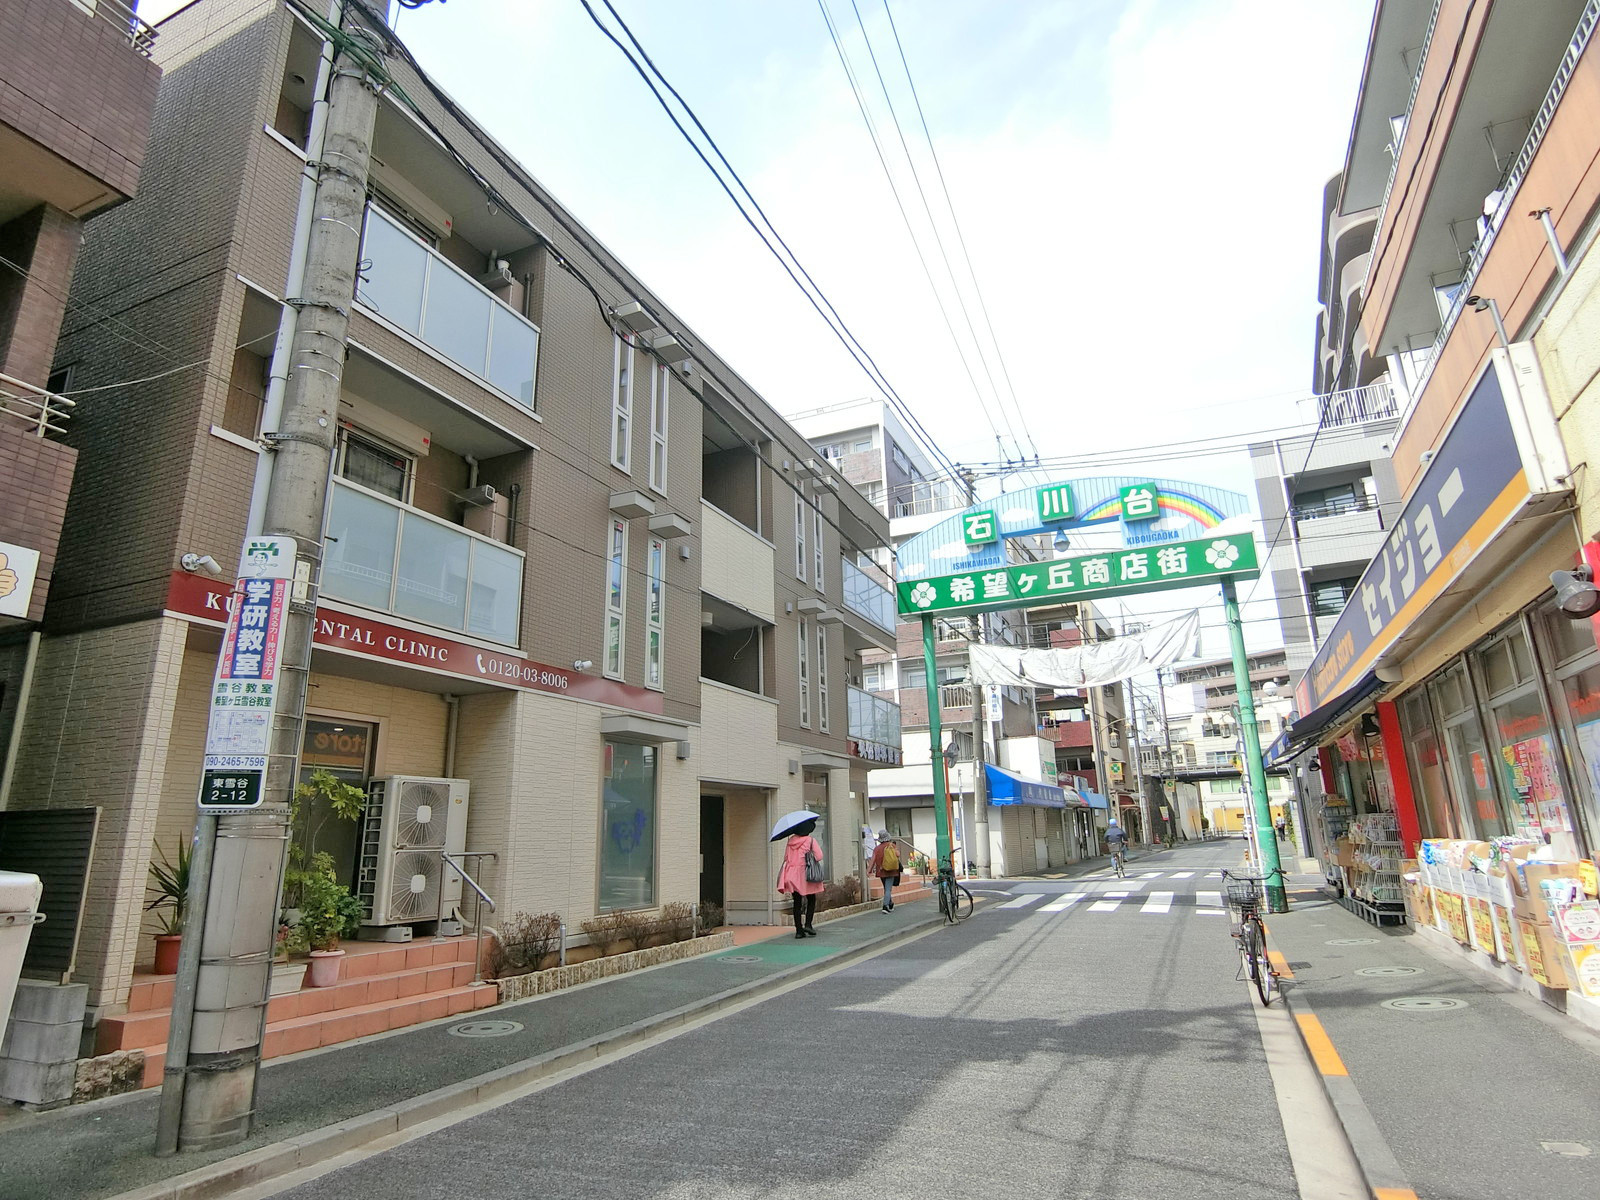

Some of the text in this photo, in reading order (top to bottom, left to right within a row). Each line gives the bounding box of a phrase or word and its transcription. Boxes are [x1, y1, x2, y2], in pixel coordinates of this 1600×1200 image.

[1126, 530, 1179, 545] KIBOUGAOKA
[1361, 467, 1464, 637] セイジョー
[952, 556, 1000, 570] ISHIKAWADAI
[233, 581, 271, 676] 学研教室
[385, 635, 449, 662] CLINIC
[488, 658, 568, 689] 0120-03-8006
[217, 683, 273, 694] 雪谷教室
[206, 756, 265, 767] 090-2465-7596
[212, 778, 249, 788] 東雪谷
[211, 790, 247, 801] 2-12
